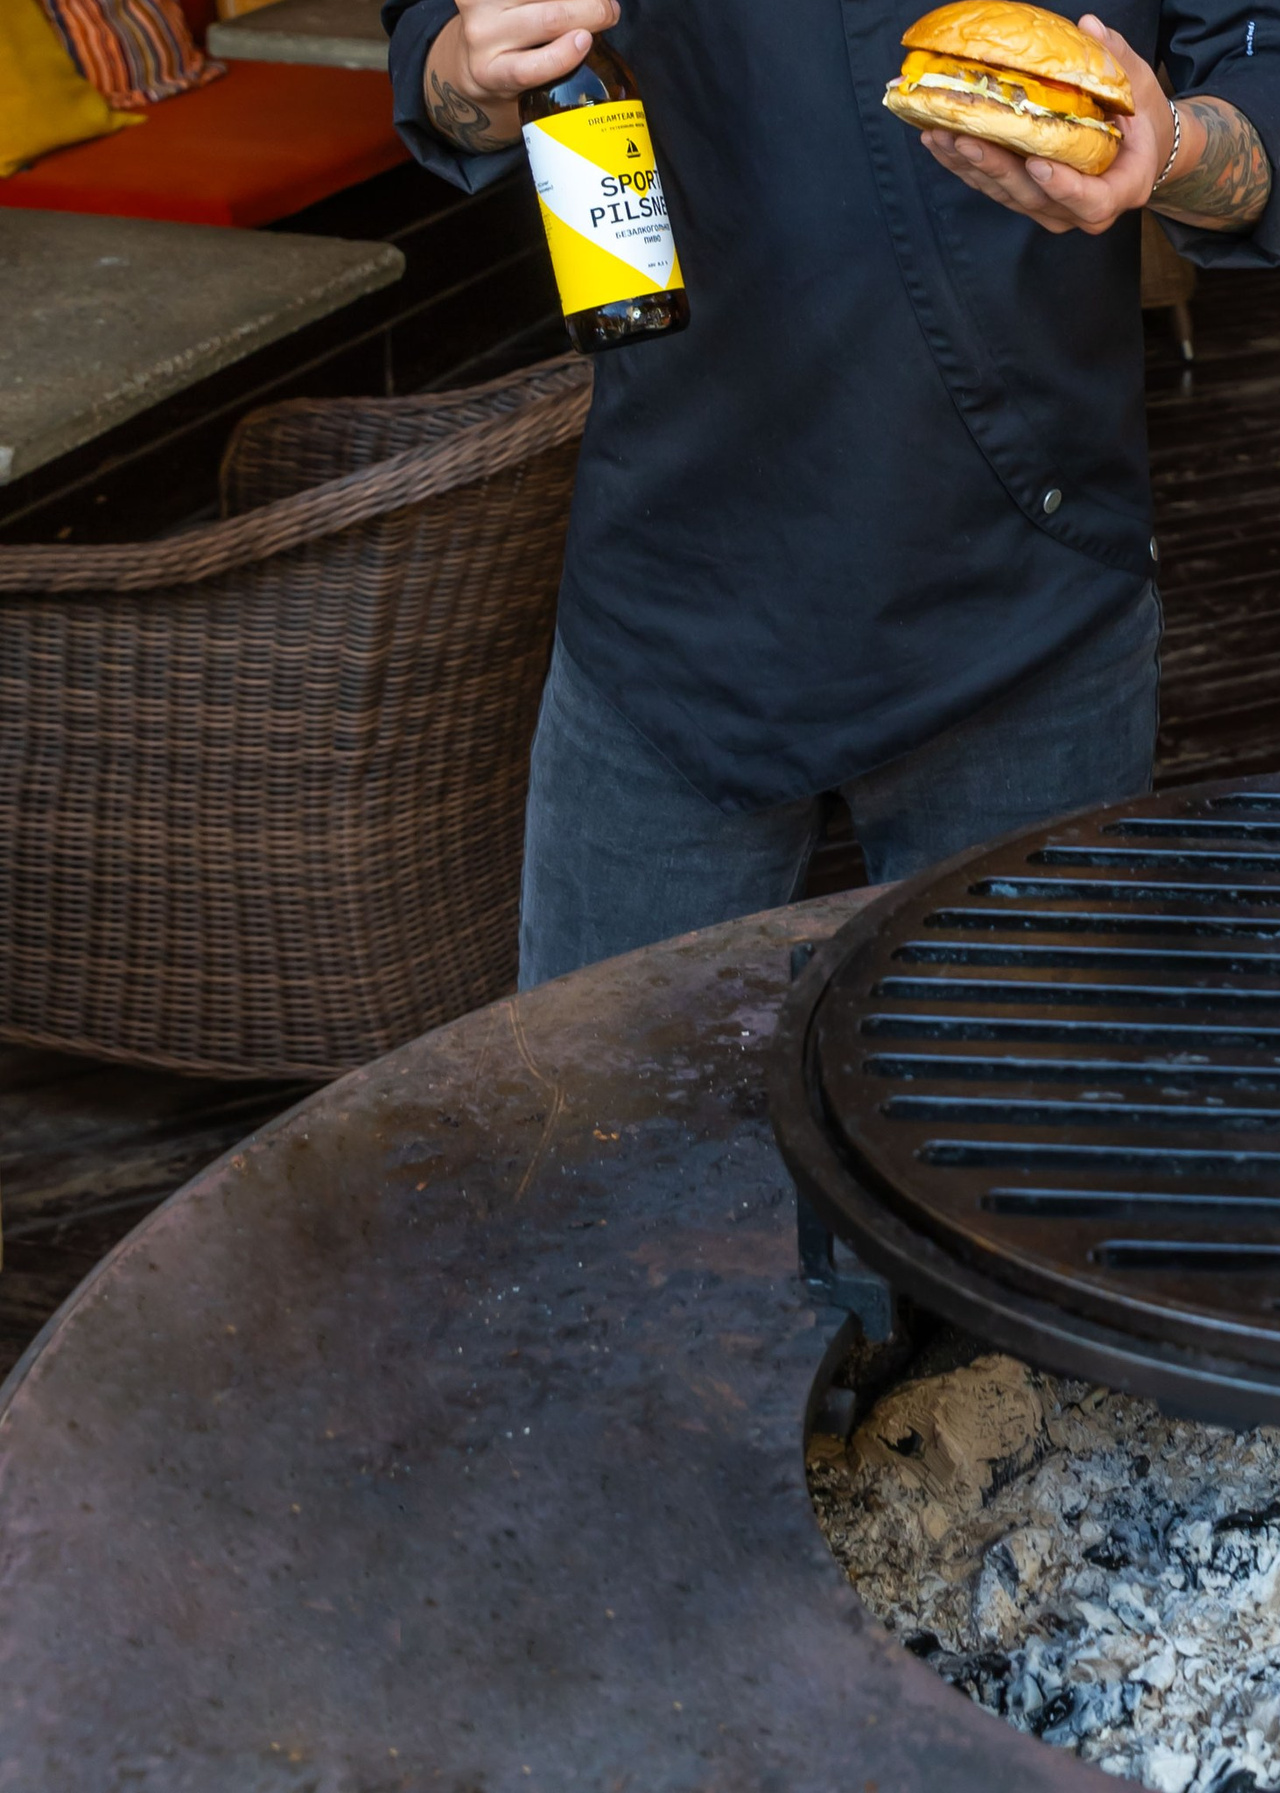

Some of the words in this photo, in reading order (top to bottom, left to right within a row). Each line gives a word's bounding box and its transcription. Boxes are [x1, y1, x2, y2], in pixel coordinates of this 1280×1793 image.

[588, 112, 634, 126] DREAMTEAM
[601, 169, 660, 197] SPORT
[590, 195, 668, 228] PILSNE
[643, 234, 662, 245] ПИВО
